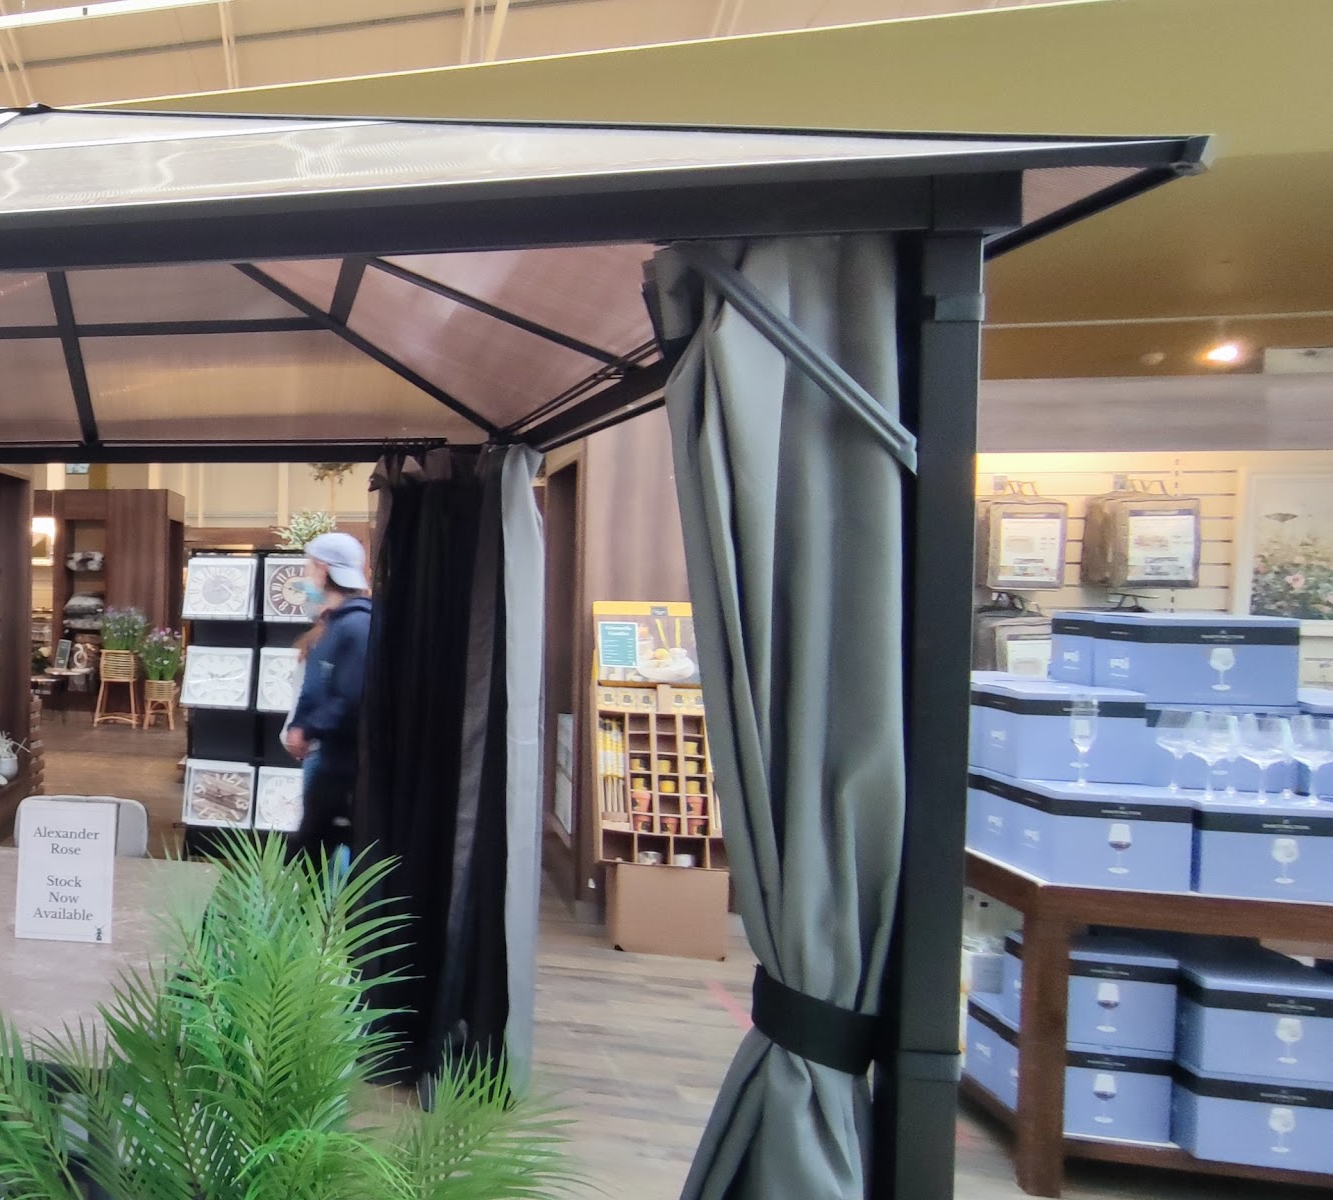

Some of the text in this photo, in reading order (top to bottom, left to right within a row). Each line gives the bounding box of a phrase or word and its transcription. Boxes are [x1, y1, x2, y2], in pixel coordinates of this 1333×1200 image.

[33, 826, 100, 840] Alexander
[50, 842, 82, 855] Rose
[46, 874, 83, 888] Stock
[48, 891, 80, 904] Now
[32, 907, 94, 921] Available
